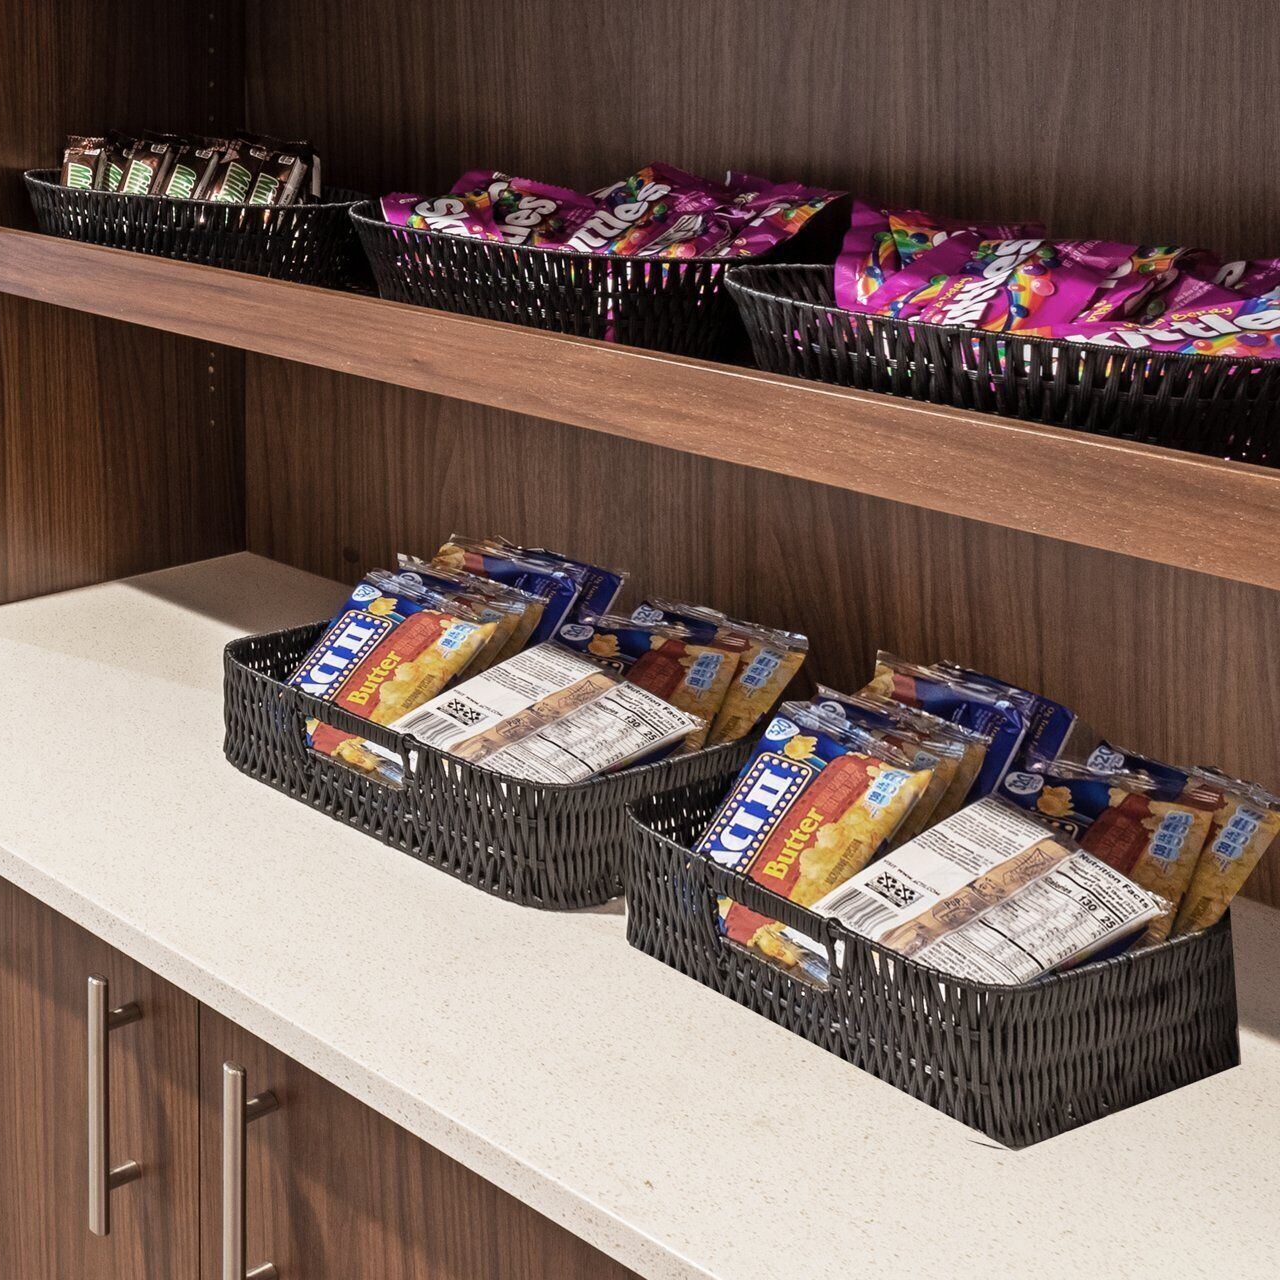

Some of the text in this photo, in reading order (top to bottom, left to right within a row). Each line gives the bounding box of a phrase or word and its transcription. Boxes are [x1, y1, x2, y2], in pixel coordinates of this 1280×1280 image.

[1169, 305, 1233, 323] Berry
[354, 585, 376, 599] 320
[333, 622, 375, 655] II
[347, 651, 403, 706] Butter
[593, 702, 619, 716] Calories
[624, 684, 686, 726] Nutrition Facts
[624, 716, 658, 741] 130 25
[769, 719, 793, 735] 320
[745, 769, 794, 812] II
[1007, 774, 1031, 790] 320
[763, 807, 825, 881] Butter
[1044, 876, 1072, 894] Calories
[1078, 854, 1149, 909] Nutrition Facts
[1078, 895, 1116, 929] 130 25
